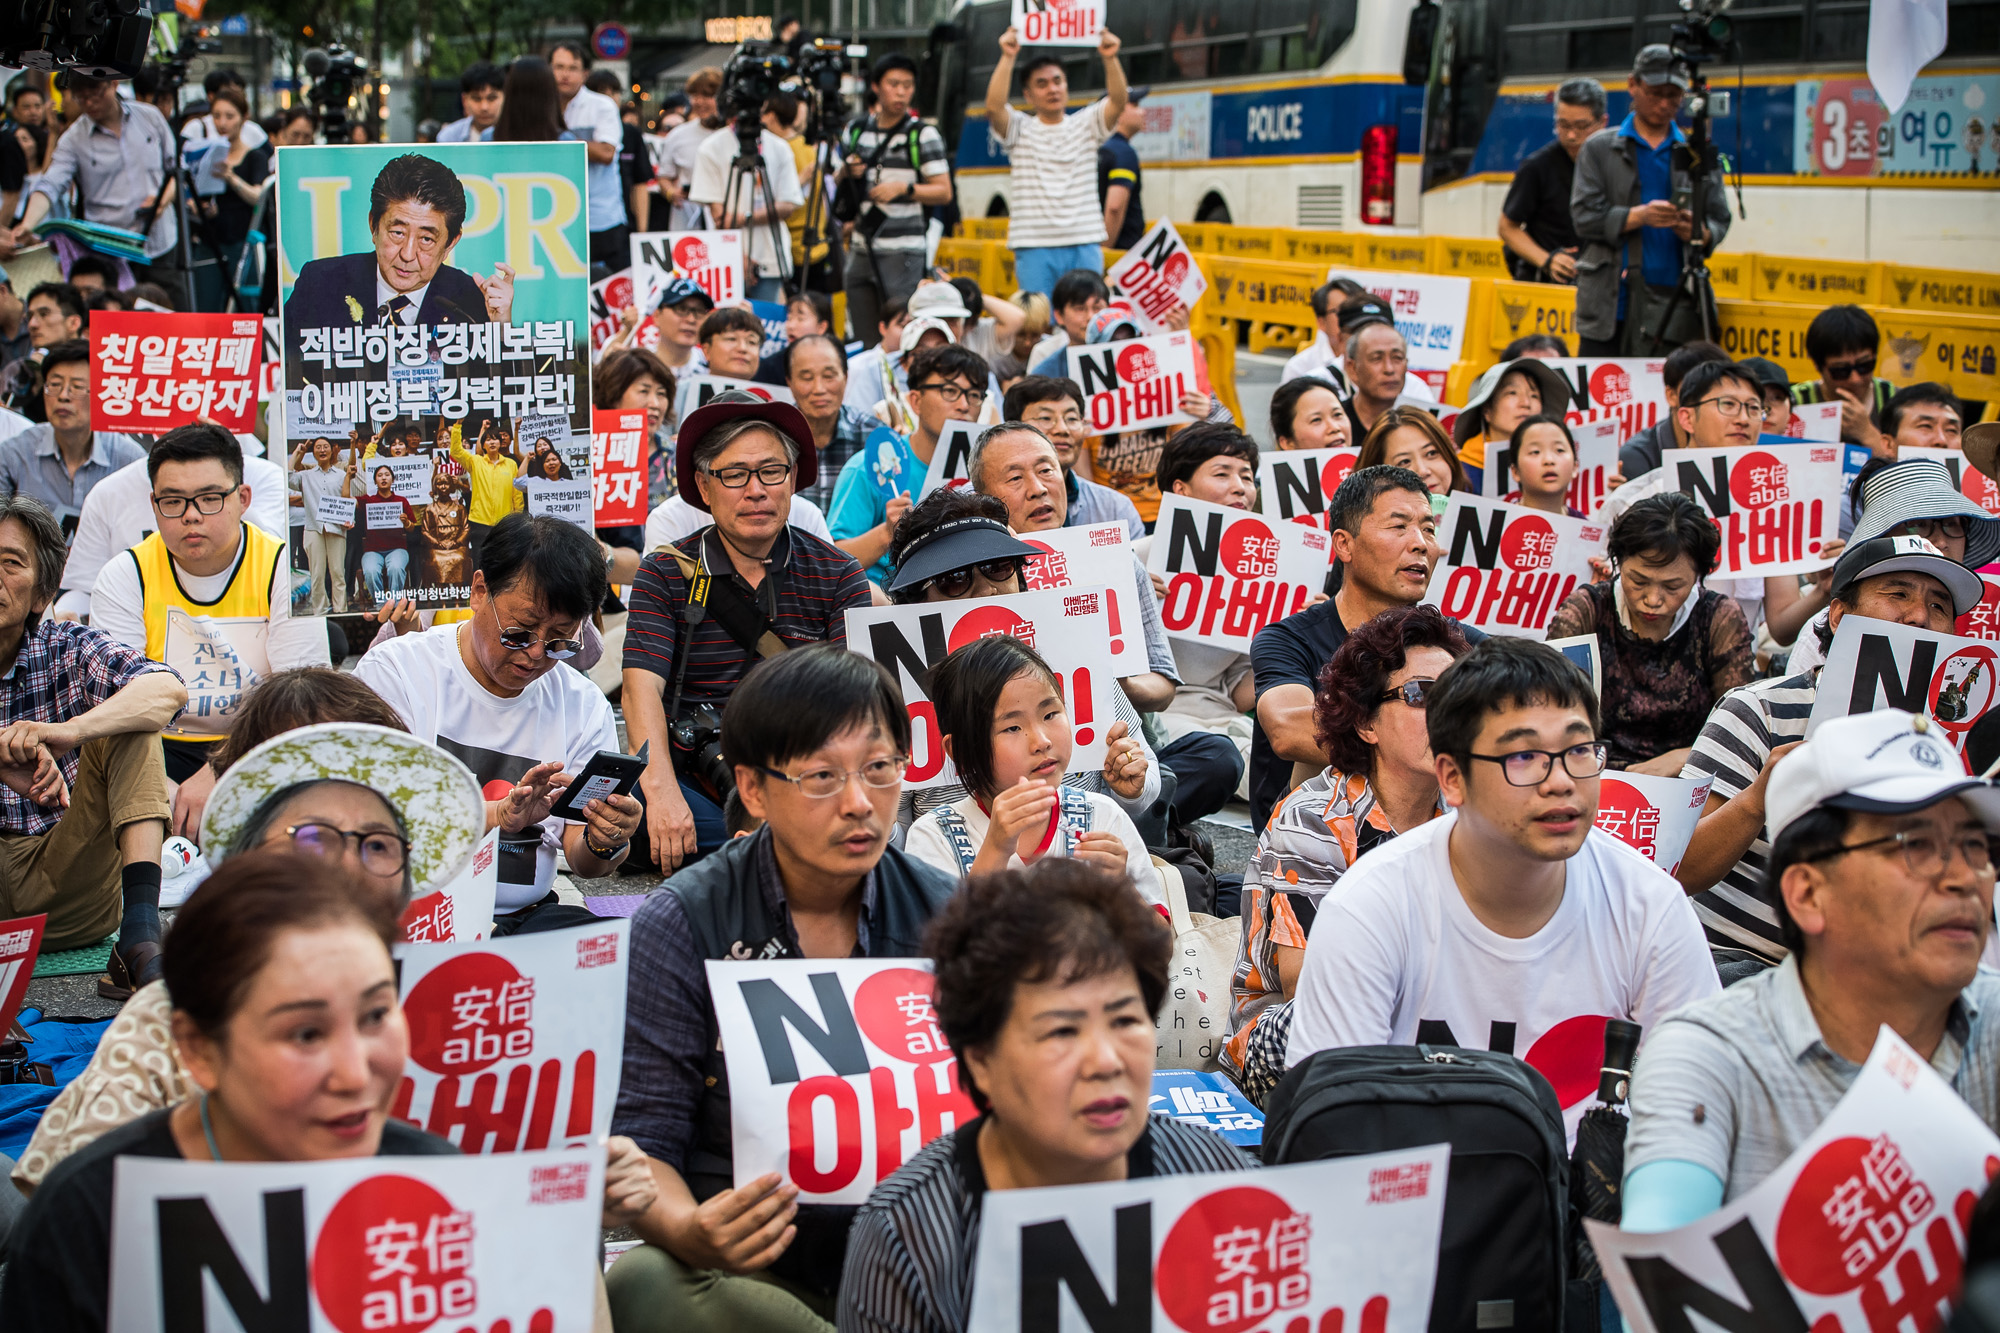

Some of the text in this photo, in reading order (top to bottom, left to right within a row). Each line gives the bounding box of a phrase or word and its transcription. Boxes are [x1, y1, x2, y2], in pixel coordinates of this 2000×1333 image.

[1025, 8, 1095, 40] 아베!
[1247, 102, 1303, 142] POLICE
[1823, 100, 1957, 170] 3초의 여유
[1920, 281, 1974, 306] POLICE
[97, 333, 256, 376] 친일적폐
[300, 320, 575, 369] 적반하장 경제보복!
[1937, 343, 1997, 376] 이 선을
[98, 375, 253, 418] 청산하자
[302, 374, 576, 424] 아베정부 강력규탄!
[1091, 372, 1186, 430] 아베!
[521, 428, 564, 442] 강력규탄한다!
[1749, 463, 1789, 489] 安倍
[534, 490, 591, 502] 매국적한일합의
[545, 503, 581, 513] 즉각폐기!
[1748, 485, 1790, 505] abe
[1089, 527, 1121, 538] 아베규탄
[1090, 536, 1122, 547] 시민행동
[1241, 535, 1280, 560] 安倍
[1521, 531, 1558, 553] 安倍
[1236, 556, 1278, 578] abe
[1514, 551, 1554, 570] abe
[374, 585, 473, 603] 반아베반일청년학생
[694, 578, 706, 602] Nikon
[1063, 593, 1098, 606] 아베규탄
[1440, 566, 1577, 630] 아베!
[1063, 603, 1099, 617] 시민행동
[1969, 600, 2000, 627] 安
[1596, 805, 1660, 839] 安倍
[407, 895, 455, 944] 安倍
[575, 948, 618, 970] 시민행동
[576, 932, 619, 955] 아베규탄
[452, 977, 536, 1031] 安倍
[895, 991, 938, 1027] 安
[442, 1026, 533, 1065] abe
[1155, 1039, 1213, 1058] rld
[1822, 1133, 1914, 1242] 安倍
[364, 1207, 478, 1282] 安倍
[1842, 1183, 1935, 1278] abe
[1213, 1213, 1313, 1283] 安倍
[361, 1270, 478, 1330] abe
[1206, 1270, 1310, 1329] abe
